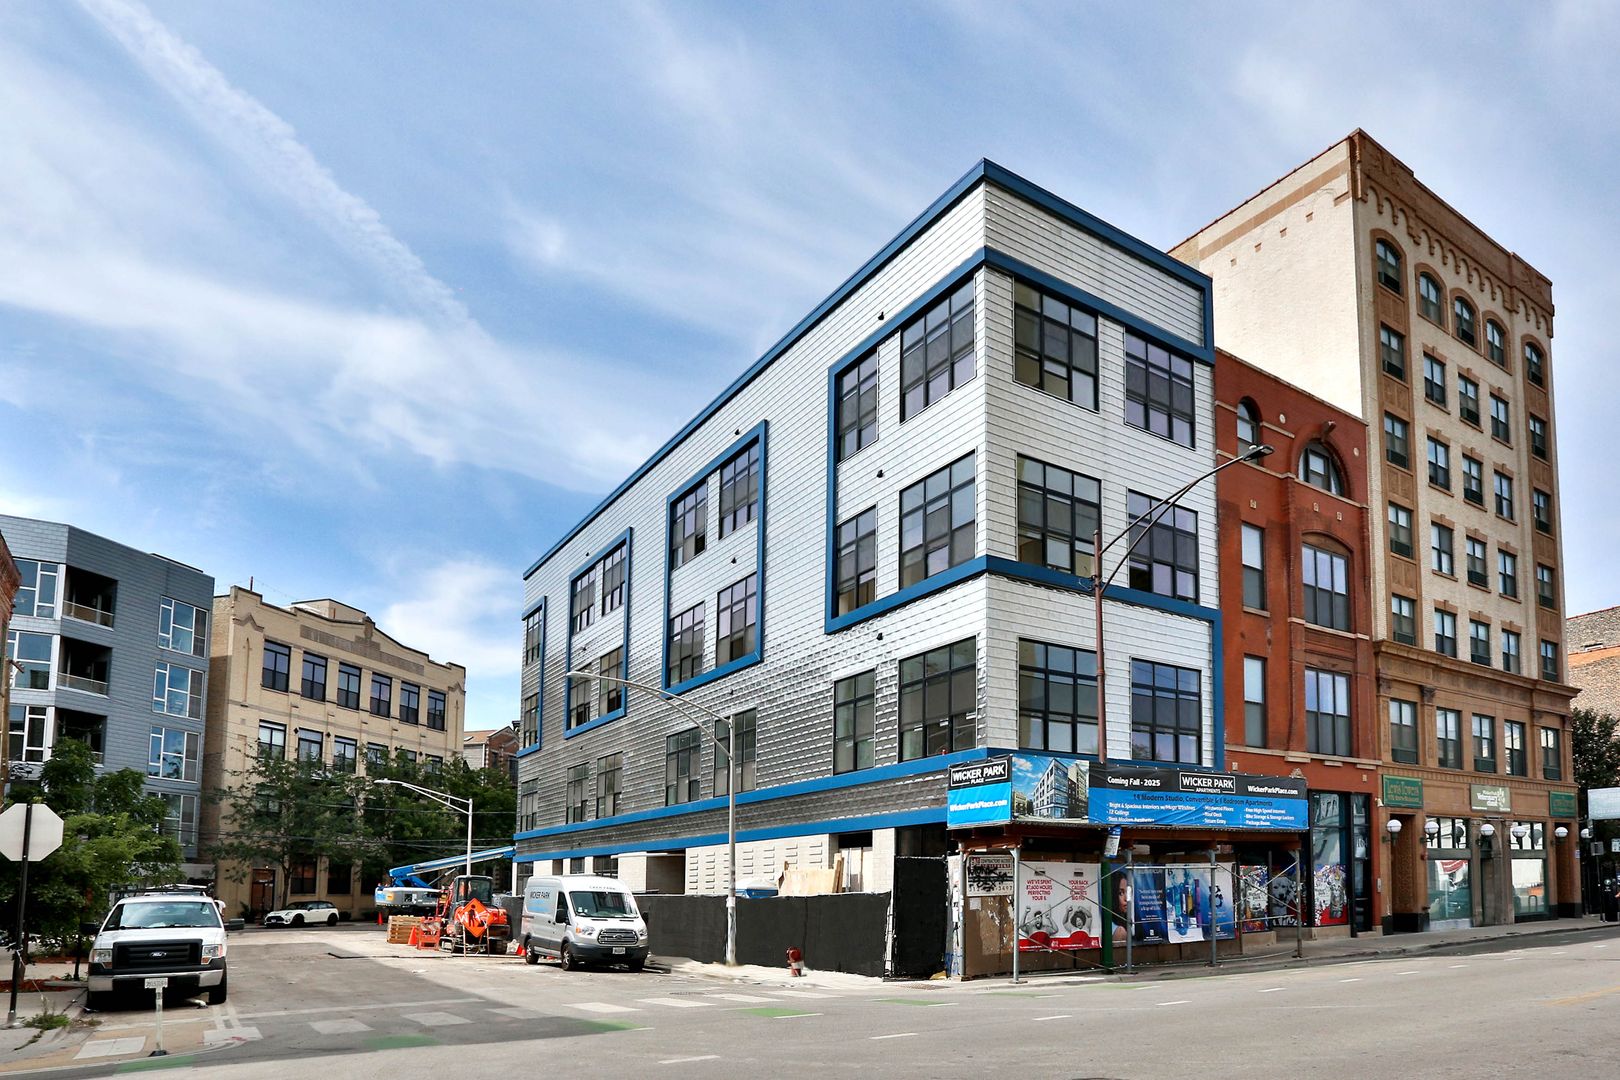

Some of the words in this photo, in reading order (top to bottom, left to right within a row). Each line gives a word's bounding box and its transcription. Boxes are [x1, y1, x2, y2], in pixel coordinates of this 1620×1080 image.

[953, 768, 981, 782] WICKER
[983, 764, 1005, 777] PARK
[1107, 776, 1129, 787] Coming
[1144, 779, 1161, 787] 2025
[1182, 777, 1213, 788] WICKER
[1214, 778, 1233, 789] PARK
[1247, 785, 1299, 795] WickerParkPlace.com
[949, 800, 1008, 812] WickerParkPlace.com
[1165, 794, 1184, 803] Studio,
[1246, 799, 1273, 807] Apartments
